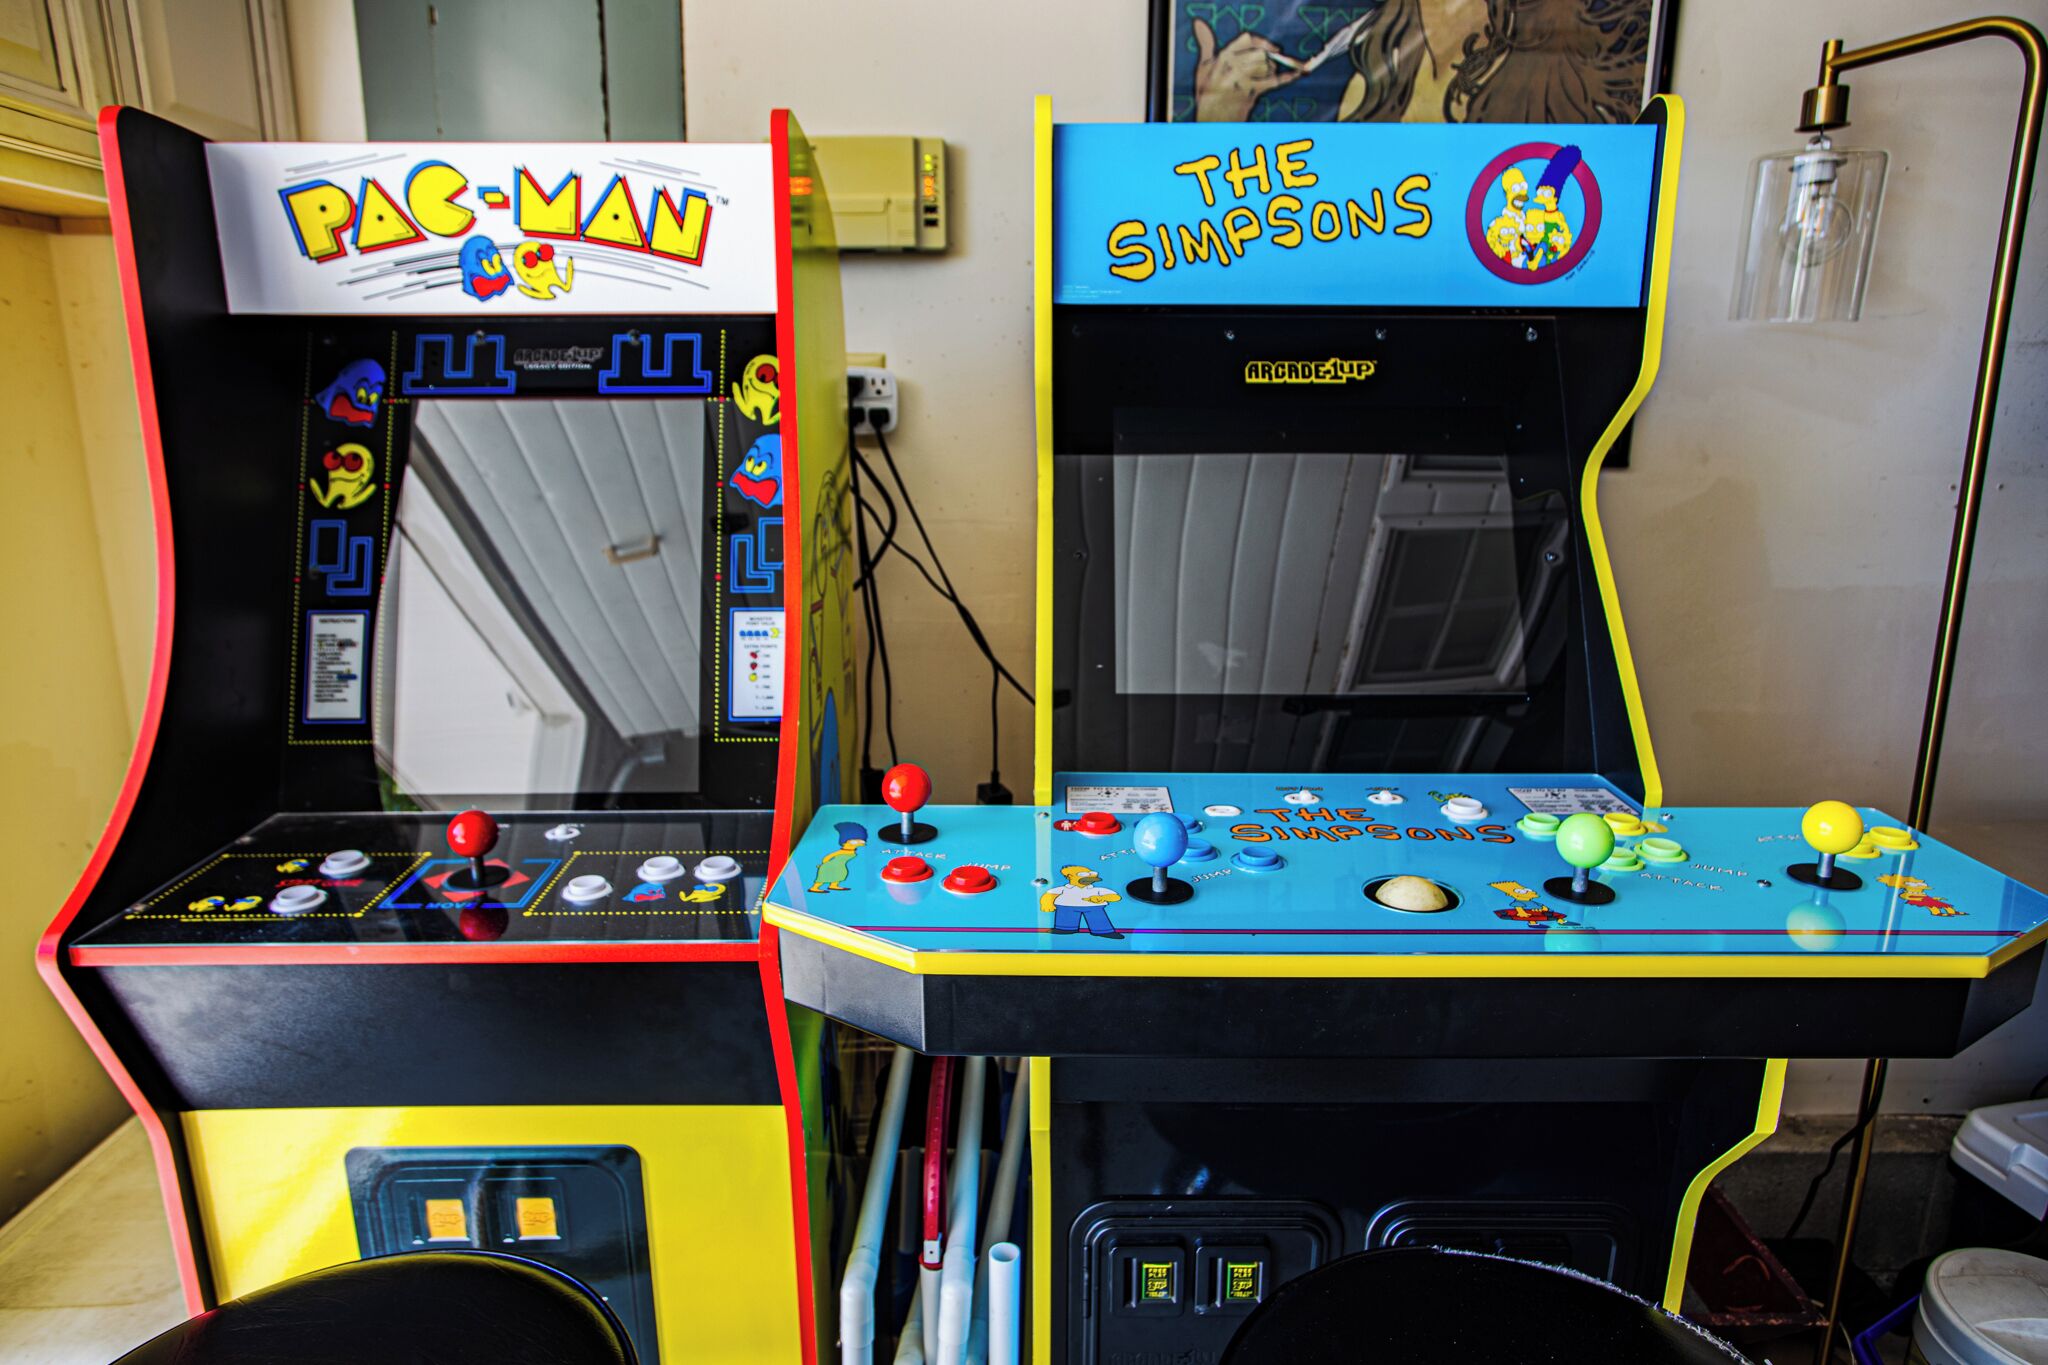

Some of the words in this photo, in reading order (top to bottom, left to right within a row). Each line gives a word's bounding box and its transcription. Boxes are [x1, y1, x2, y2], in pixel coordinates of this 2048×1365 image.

[1174, 138, 1319, 207] THE
[278, 160, 714, 267] PAC-MAN
[1107, 174, 1433, 281] SIMPSONS
[1254, 807, 1375, 823] THE
[1230, 823, 1515, 844] SIMPSONS
[881, 848, 947, 860] ATTACK
[1192, 868, 1233, 884] JUMP
[1690, 863, 1748, 877] JUMP
[1640, 872, 1725, 892] ATTACK
